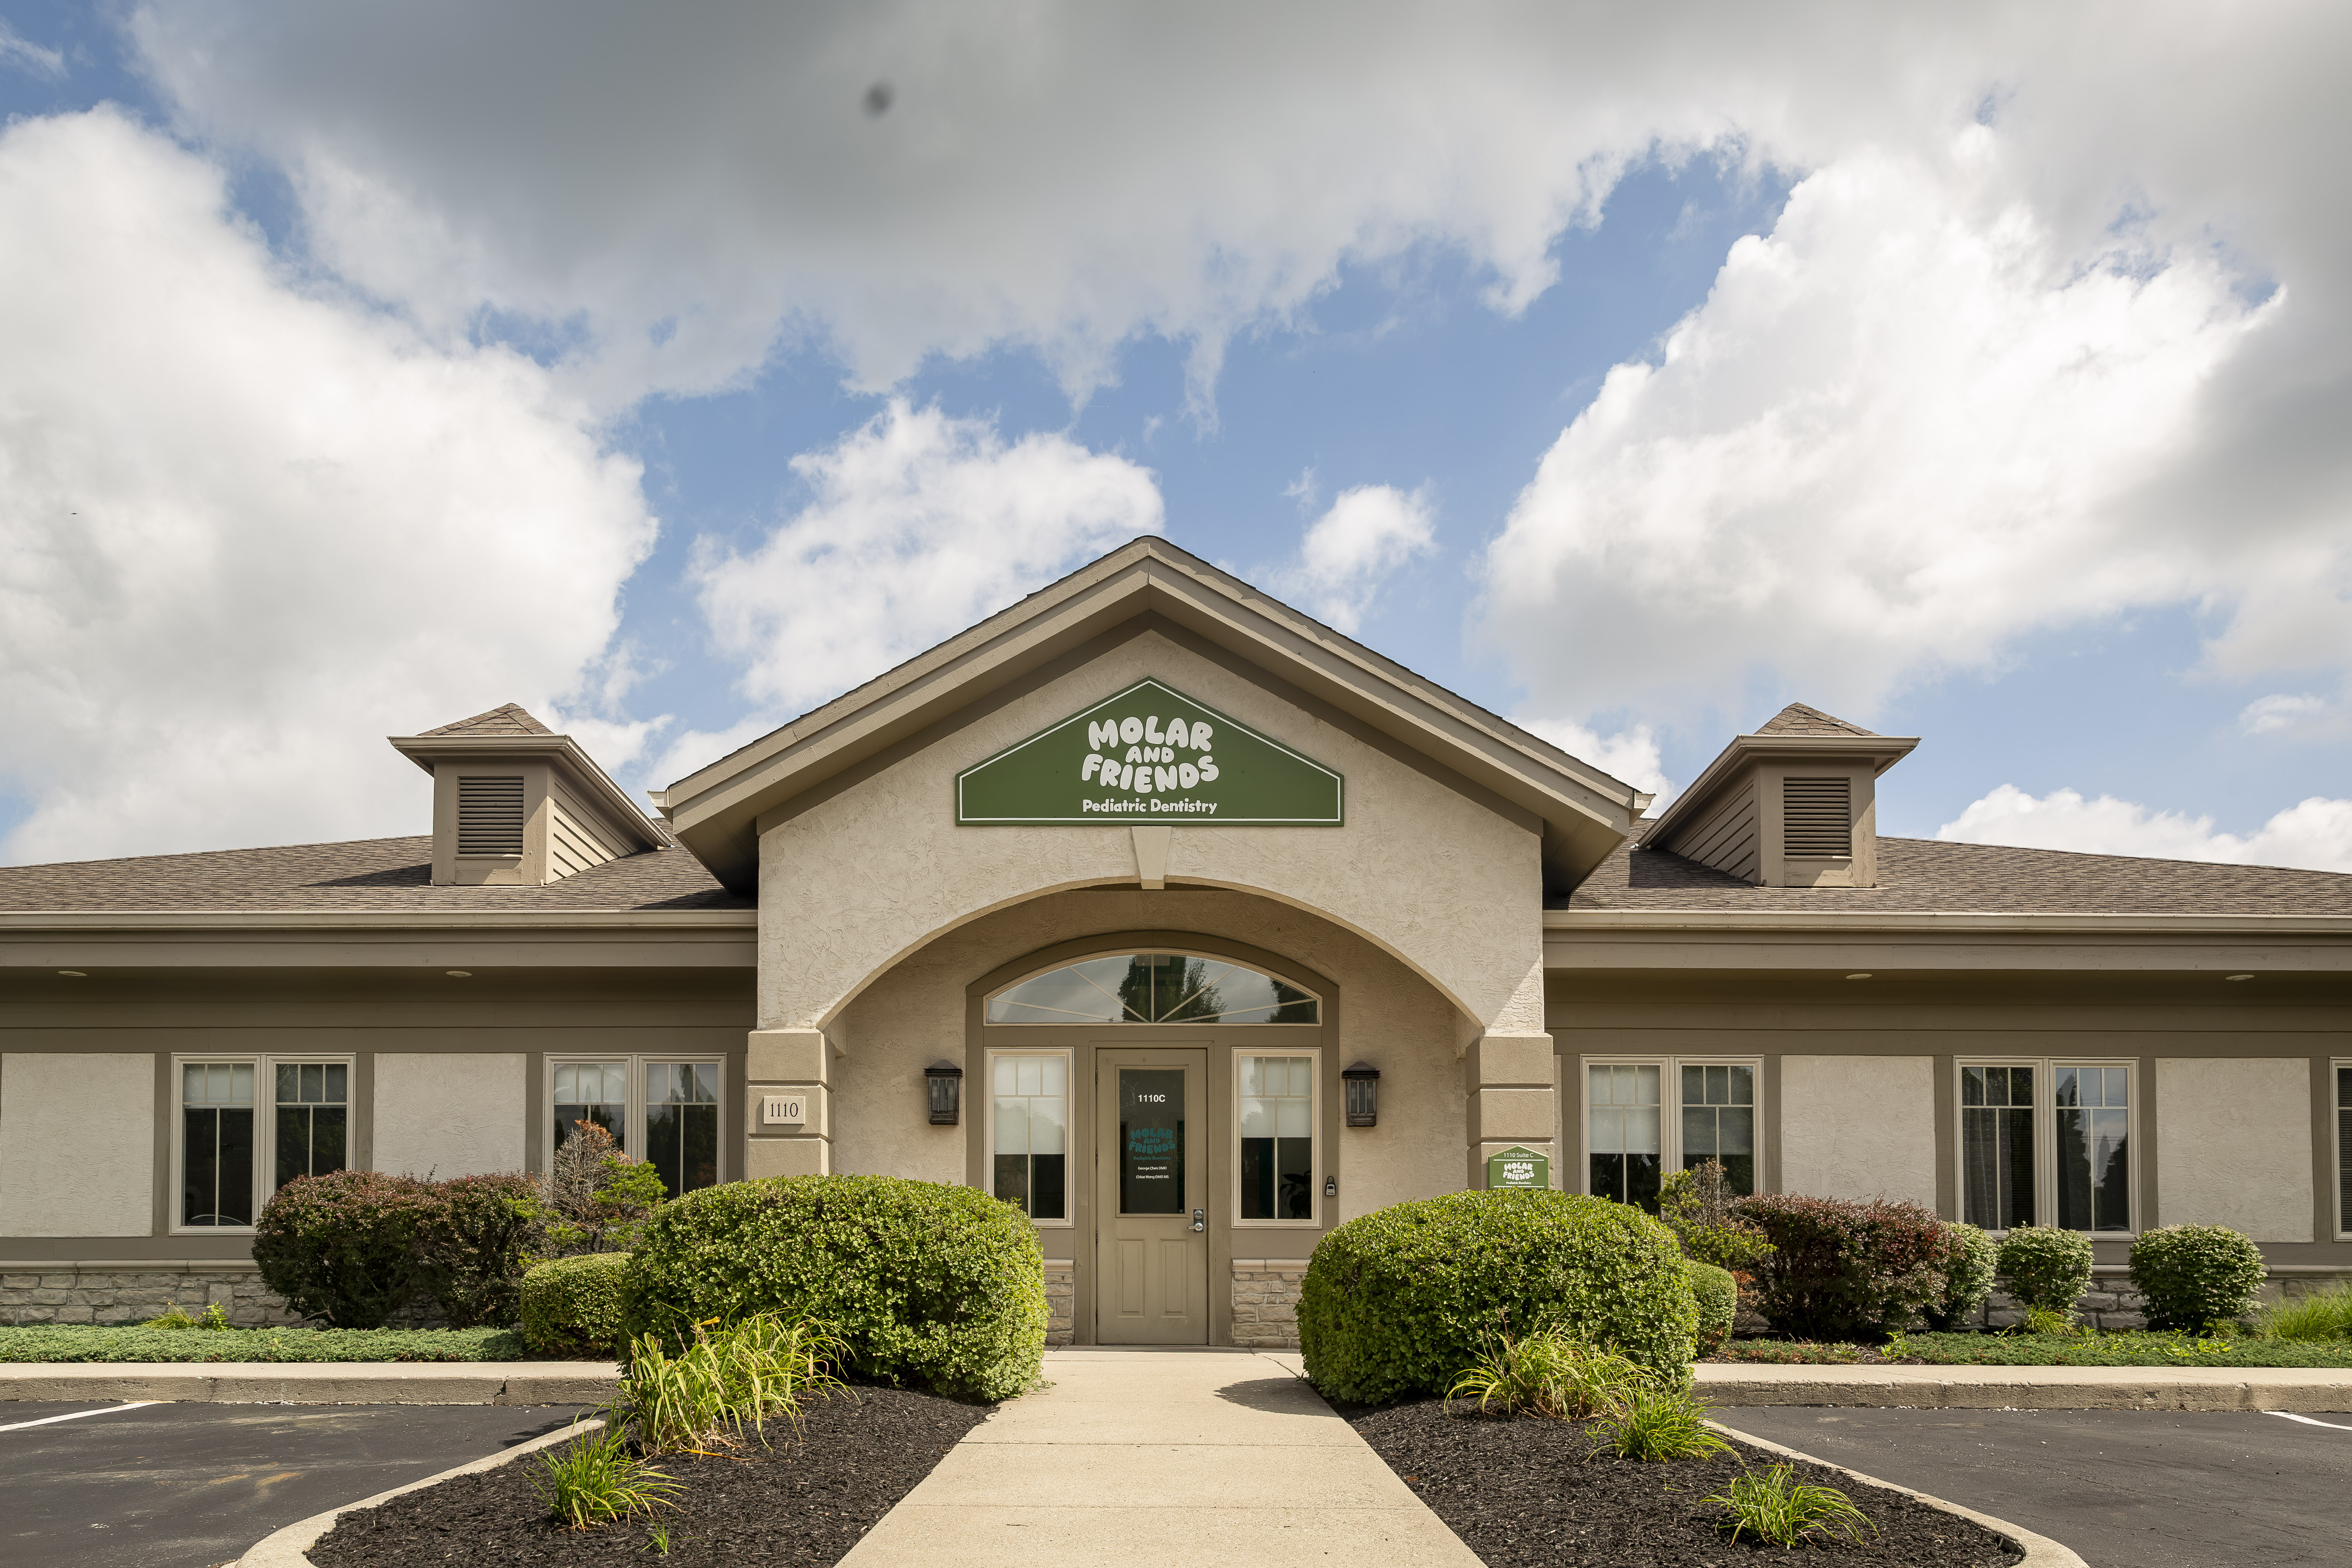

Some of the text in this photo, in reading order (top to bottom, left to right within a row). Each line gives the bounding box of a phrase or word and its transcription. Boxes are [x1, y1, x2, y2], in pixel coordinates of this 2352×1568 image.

[1088, 716, 1213, 752] MOLAR
[1125, 745, 1174, 763] AND
[1081, 753, 1219, 793] FRIENDS
[1082, 798, 1217, 814] Pediatric Dentistry
[1138, 1094, 1165, 1102] 1110C
[770, 1102, 799, 1117] 1110
[1130, 1127, 1173, 1140] MOLAR
[1129, 1140, 1175, 1154] FRIENDS
[1504, 1162, 1533, 1171] MOLAR
[1503, 1171, 1535, 1180] FRIENDS
